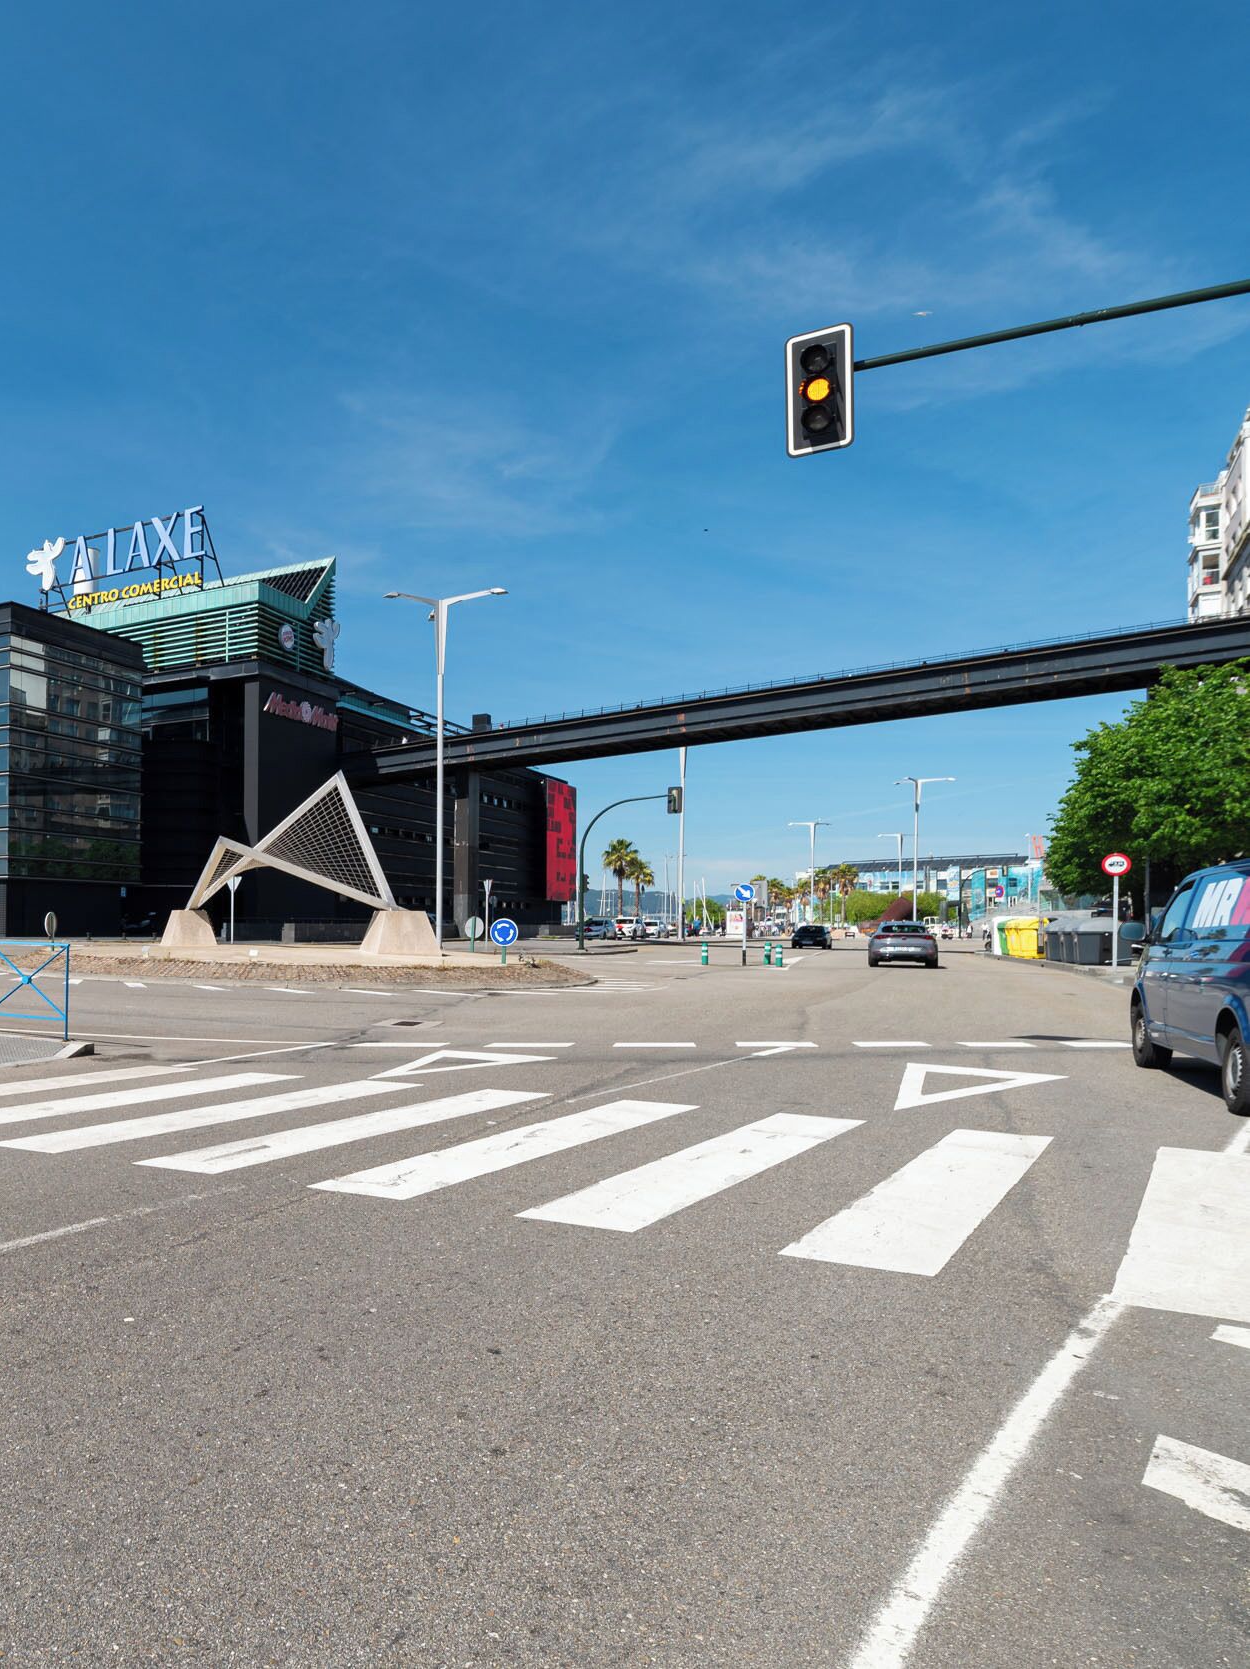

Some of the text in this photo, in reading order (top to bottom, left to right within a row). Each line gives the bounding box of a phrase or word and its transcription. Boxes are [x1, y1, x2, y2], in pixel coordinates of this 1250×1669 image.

[69, 505, 206, 585] A LAXE
[67, 571, 202, 610] CENTRO COMERCIAL
